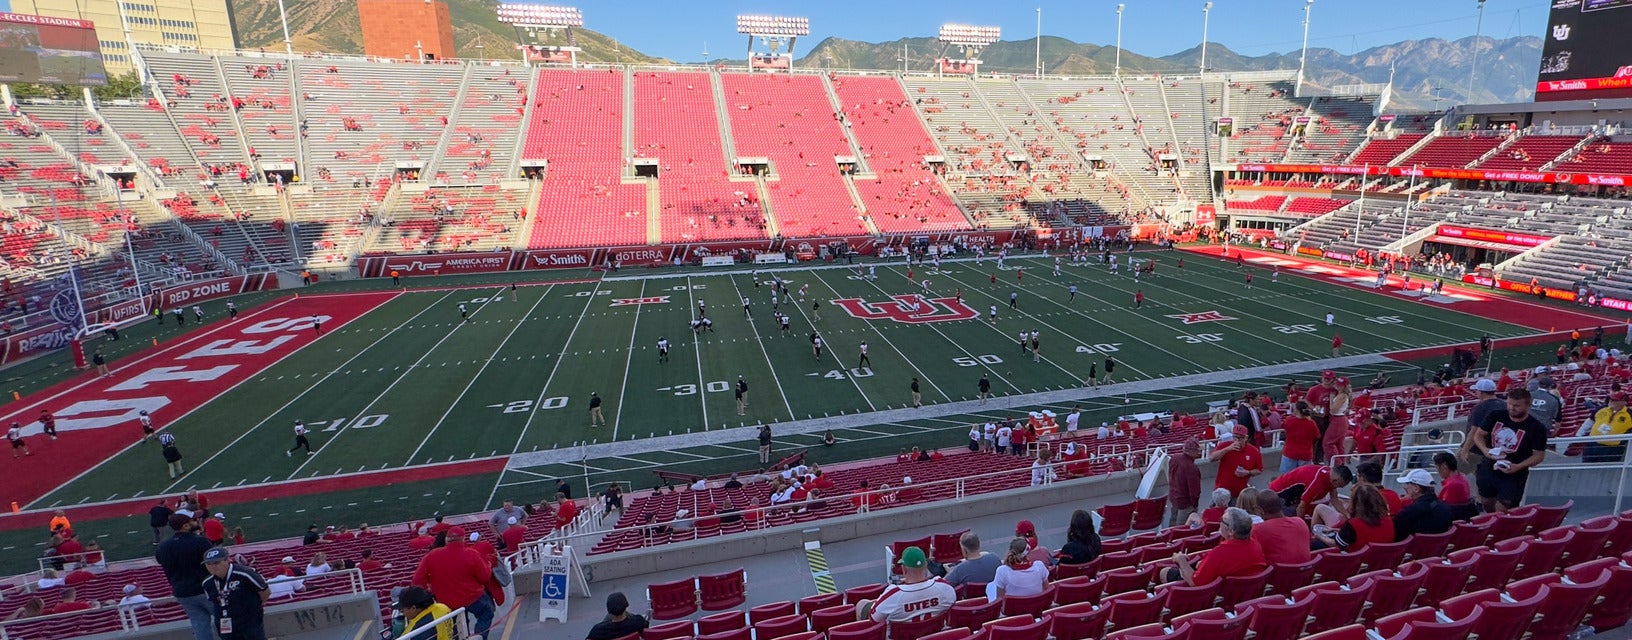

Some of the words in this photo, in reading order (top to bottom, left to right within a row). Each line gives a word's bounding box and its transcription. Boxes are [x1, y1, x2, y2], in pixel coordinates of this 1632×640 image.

[40, 17, 81, 27] STADIUM
[1560, 80, 1587, 90] Smith's
[1598, 78, 1627, 88] When
[969, 235, 994, 243] HEALTH
[446, 258, 481, 266] AMERICA
[550, 253, 586, 266] Smith's
[170, 290, 191, 305] RED
[192, 281, 231, 299] ZONE
[1603, 298, 1626, 310] UTAH
[1177, 332, 1224, 344] 30
[1074, 342, 1123, 356] 40
[951, 353, 1003, 368] 50
[0, 315, 333, 441] UTES
[823, 366, 875, 380] 40
[673, 380, 730, 396] 30
[502, 396, 570, 414] 20
[320, 414, 390, 432] 10
[543, 565, 567, 574] SEATING
[903, 597, 940, 613] UTES
